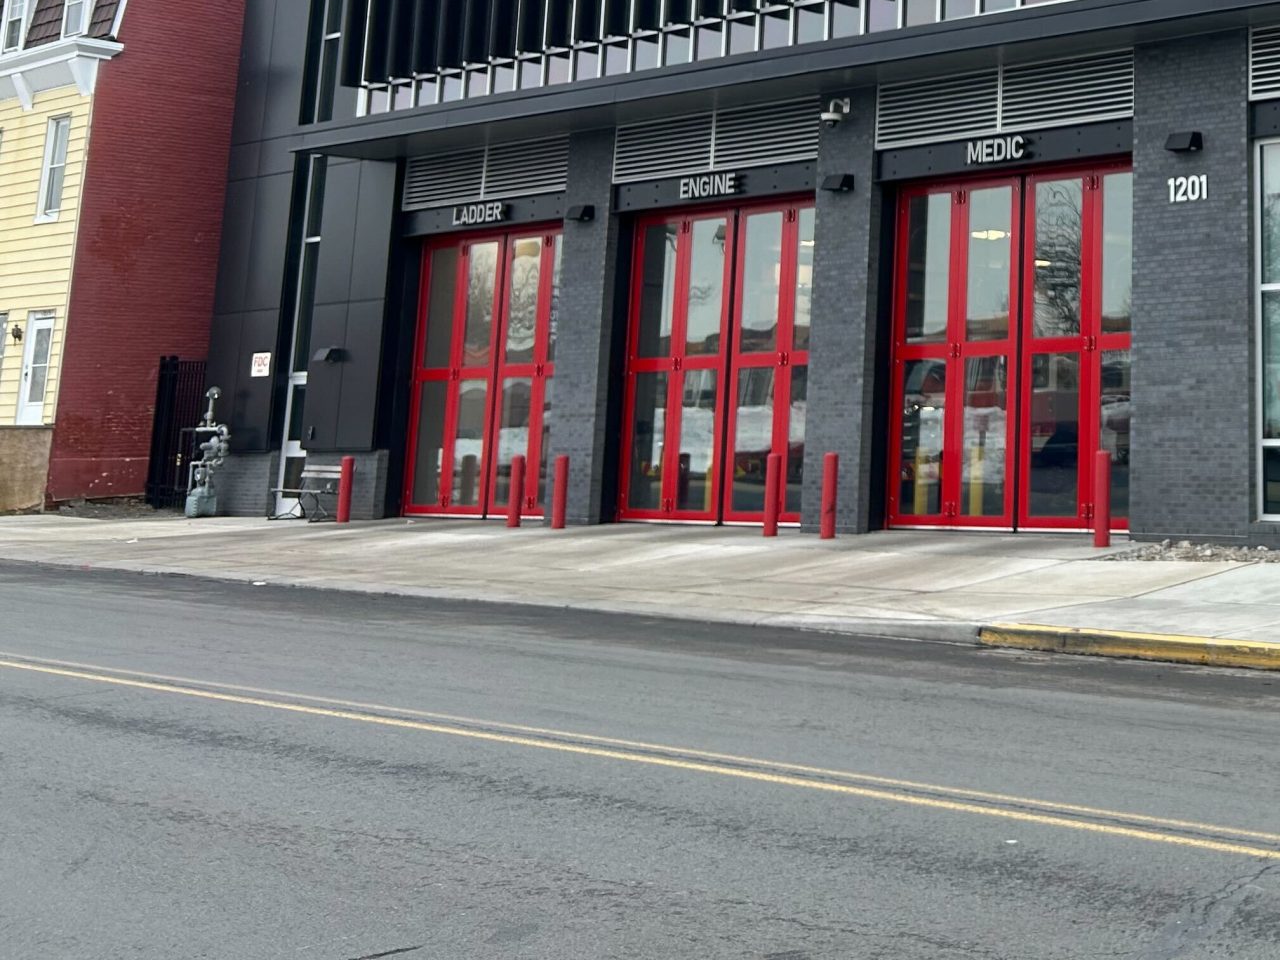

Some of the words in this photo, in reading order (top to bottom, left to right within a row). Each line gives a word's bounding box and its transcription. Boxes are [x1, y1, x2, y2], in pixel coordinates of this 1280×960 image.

[966, 135, 1025, 165] MEDIC
[679, 172, 737, 200] ENGINE
[1166, 173, 1209, 204] 1201
[451, 202, 503, 226] LADDER
